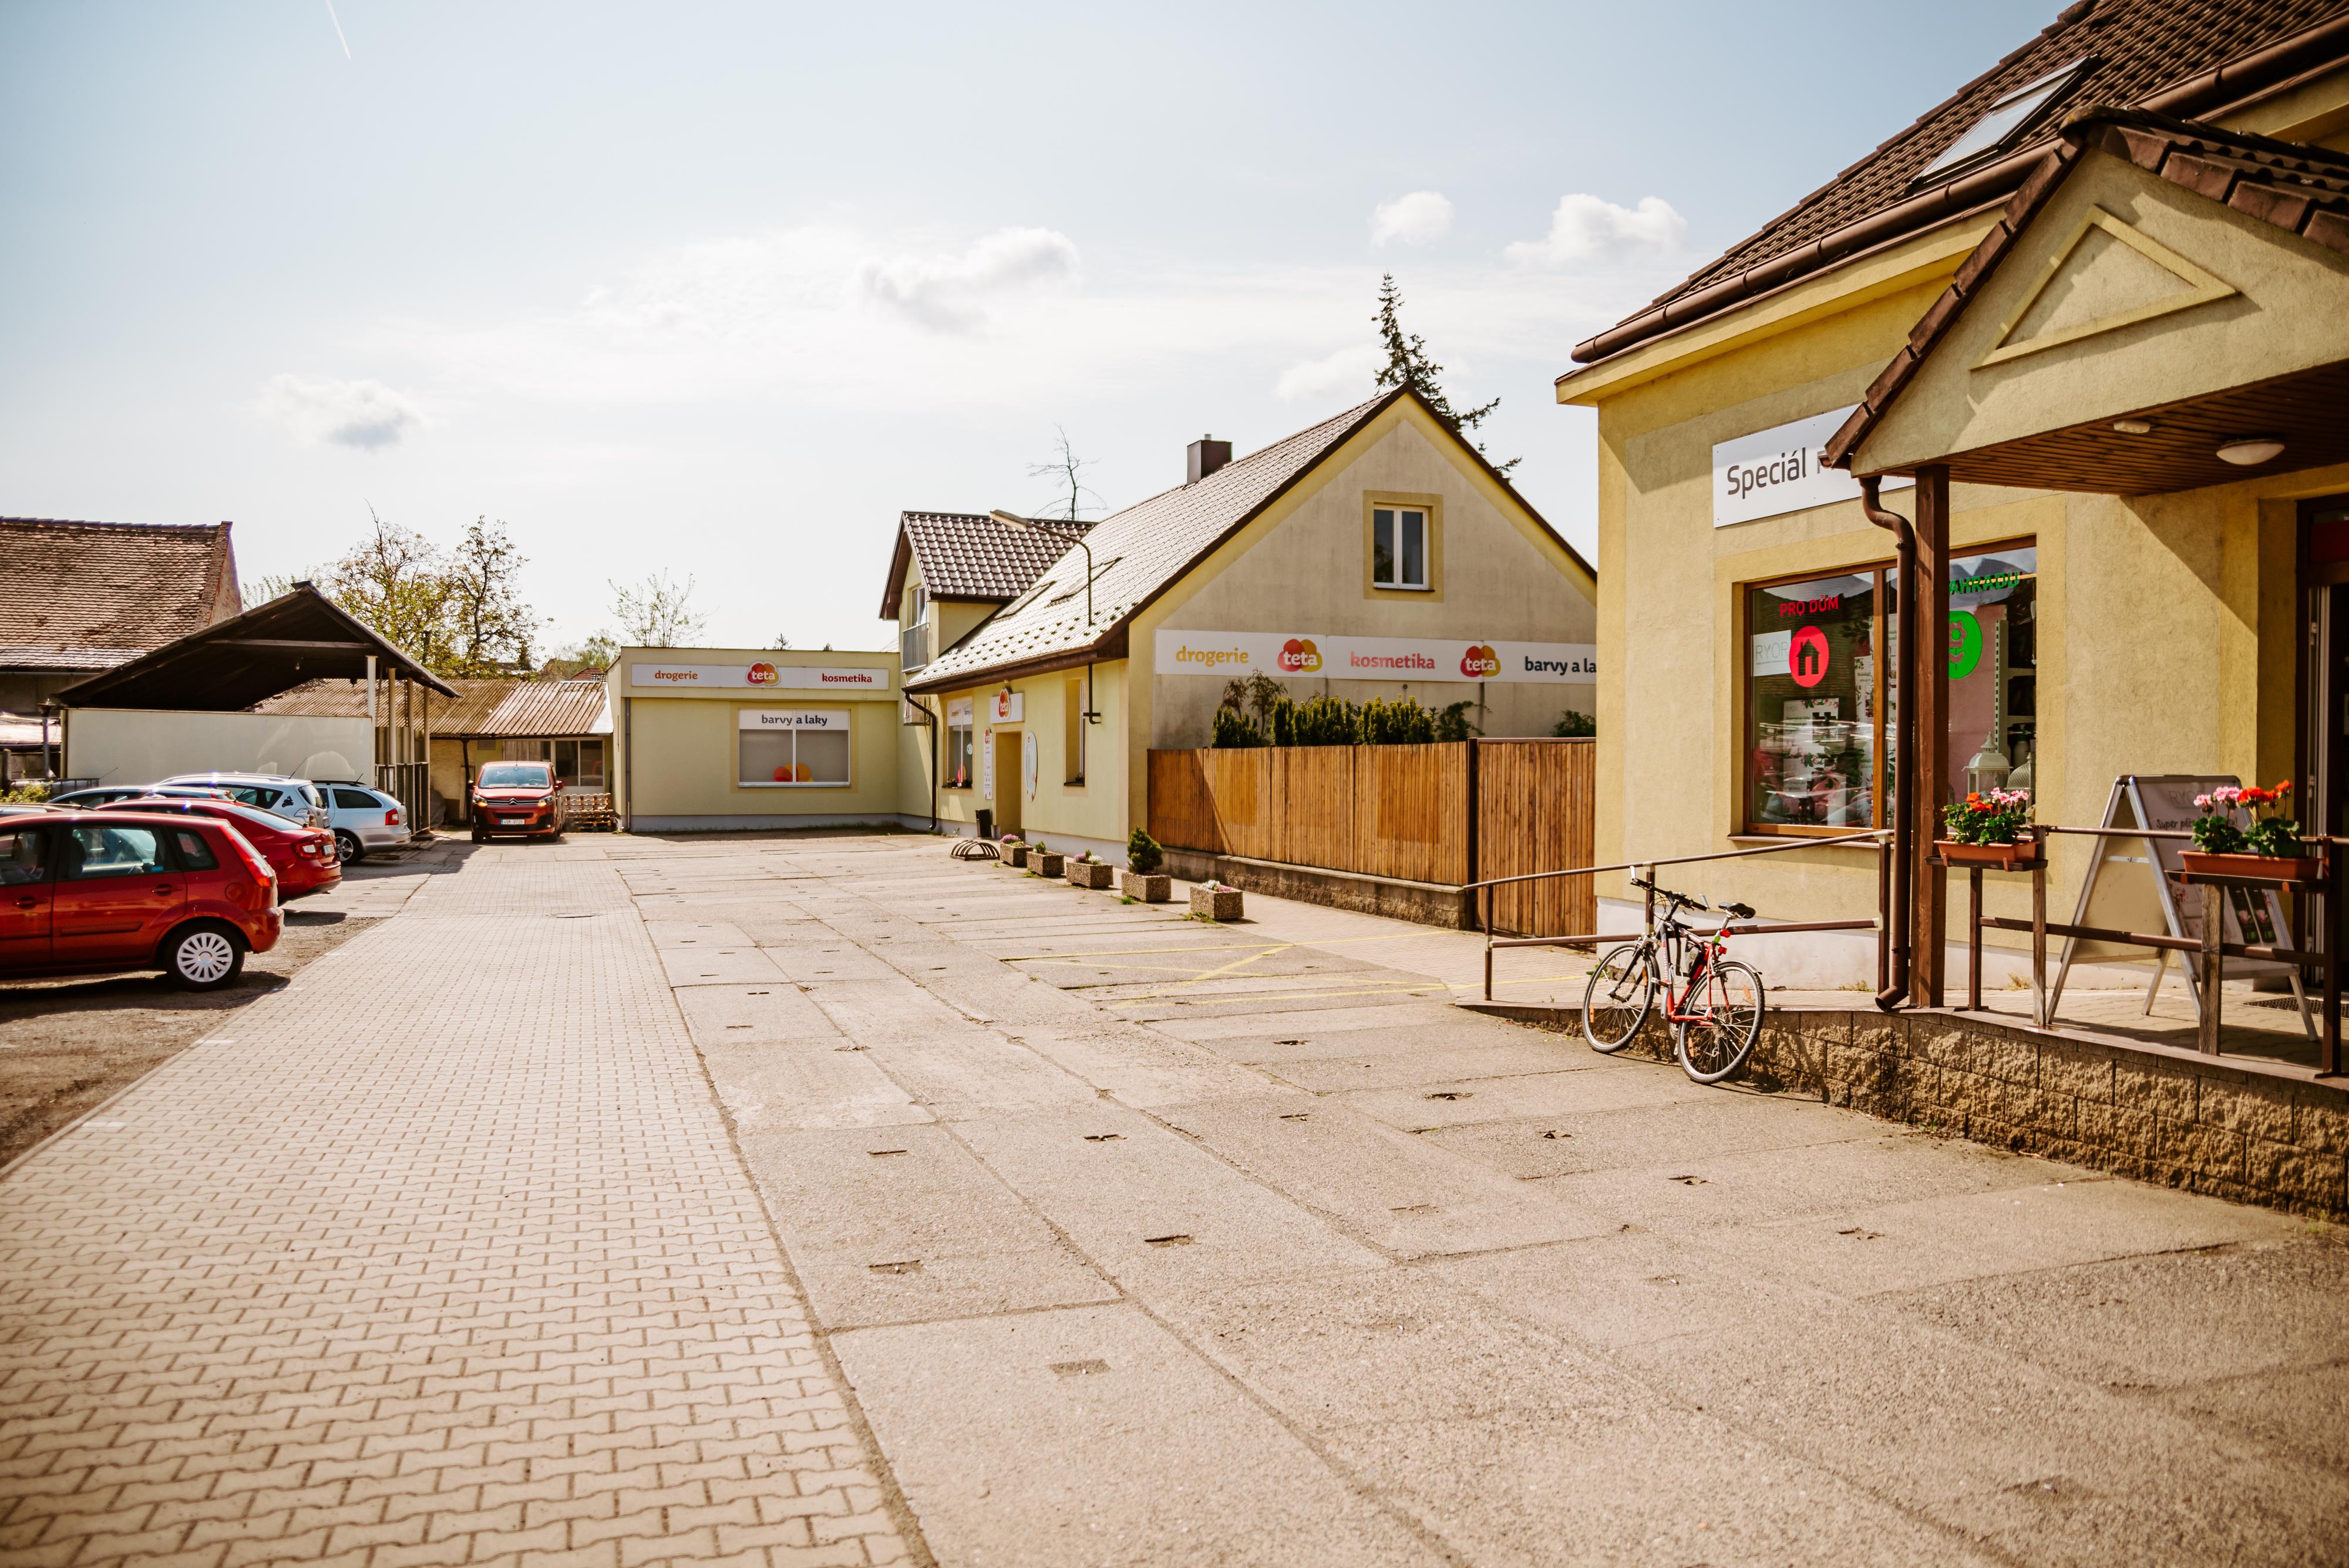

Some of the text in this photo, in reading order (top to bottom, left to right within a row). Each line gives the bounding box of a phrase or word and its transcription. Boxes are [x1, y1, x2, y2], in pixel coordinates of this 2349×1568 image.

[1727, 447, 1806, 499] Speciál
[1949, 571, 2019, 594] AHRADU
[1779, 594, 1839, 617] PRO DŮM
[1176, 645, 1597, 676] drogerie teta kosmetika teta barvy a la
[1755, 641, 1789, 660] RYOR
[654, 670, 873, 682] drogerie teta kosmetika
[999, 701, 1008, 712] teta
[762, 714, 793, 726] barvy
[805, 715, 828, 726] laky
